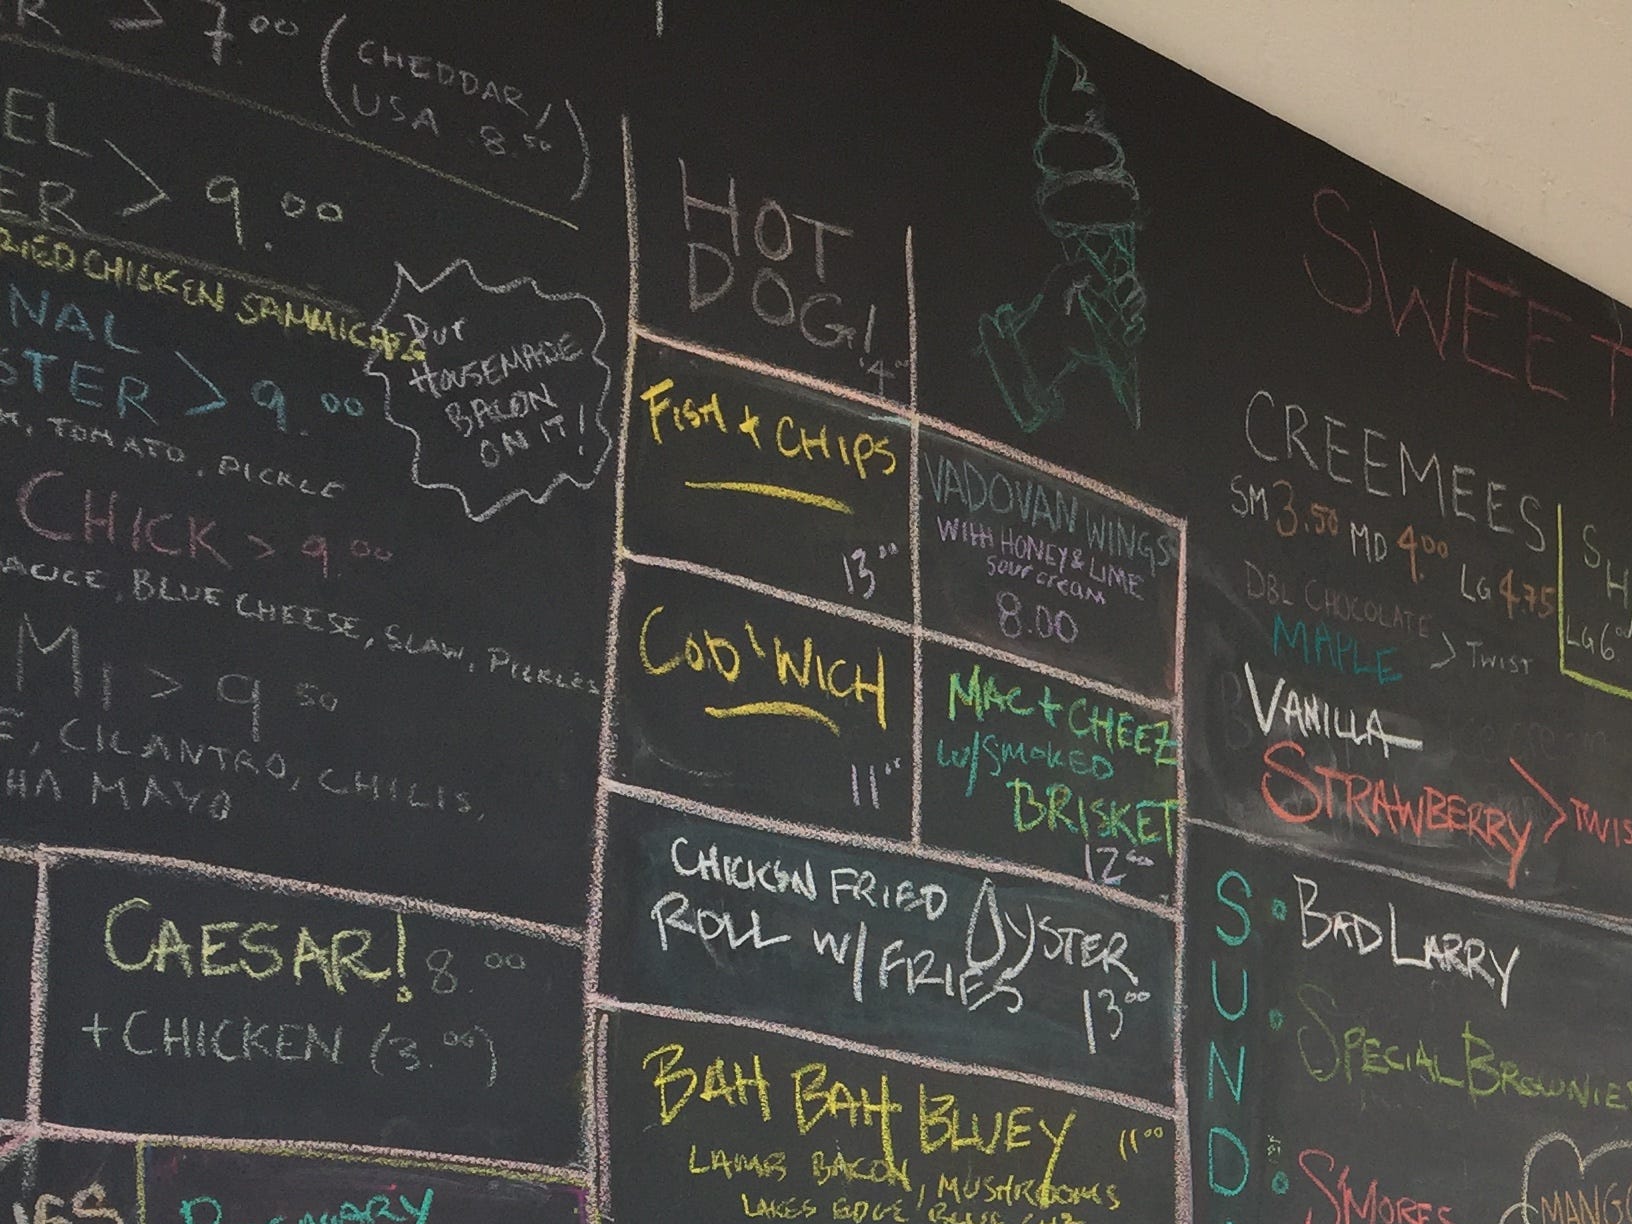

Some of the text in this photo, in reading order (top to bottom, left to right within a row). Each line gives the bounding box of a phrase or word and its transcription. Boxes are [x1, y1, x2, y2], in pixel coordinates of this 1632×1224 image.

[353, 84, 440, 137] USA
[679, 158, 853, 280] HOT
[83, 248, 224, 312] CHICKEN
[409, 333, 584, 398] HOUSEMADE
[445, 383, 558, 437] BACON
[640, 378, 728, 445] FISH
[775, 415, 897, 480] CHIPS
[480, 429, 529, 467] ON
[1245, 391, 1546, 552] CREEMEES
[17, 470, 233, 570] CHICK
[1231, 475, 1269, 521] SM
[1350, 521, 1387, 563] MD
[1459, 563, 1491, 602] LG
[133, 568, 221, 607] BLUE
[1304, 578, 1432, 639] CHOCOLATE
[1273, 615, 1533, 685] MAPLE TWIST
[948, 664, 1035, 722] MAC
[1245, 662, 1423, 758] VANILLA
[91, 771, 232, 821] MAYO
[1006, 777, 1178, 858] BRISKET
[1261, 740, 1532, 889] STRAWBERRY
[831, 868, 949, 922] FRIED
[651, 891, 792, 950] ROLL
[878, 940, 1024, 1014] FRIES
[1390, 903, 1520, 1008] LARRY
[122, 1010, 344, 1064] CHICKEN
[1297, 983, 1464, 1085] SPECIAL
[643, 1044, 772, 1126] BAH
[793, 1062, 902, 1172] BAH
[919, 1084, 1078, 1208] BLUEY
